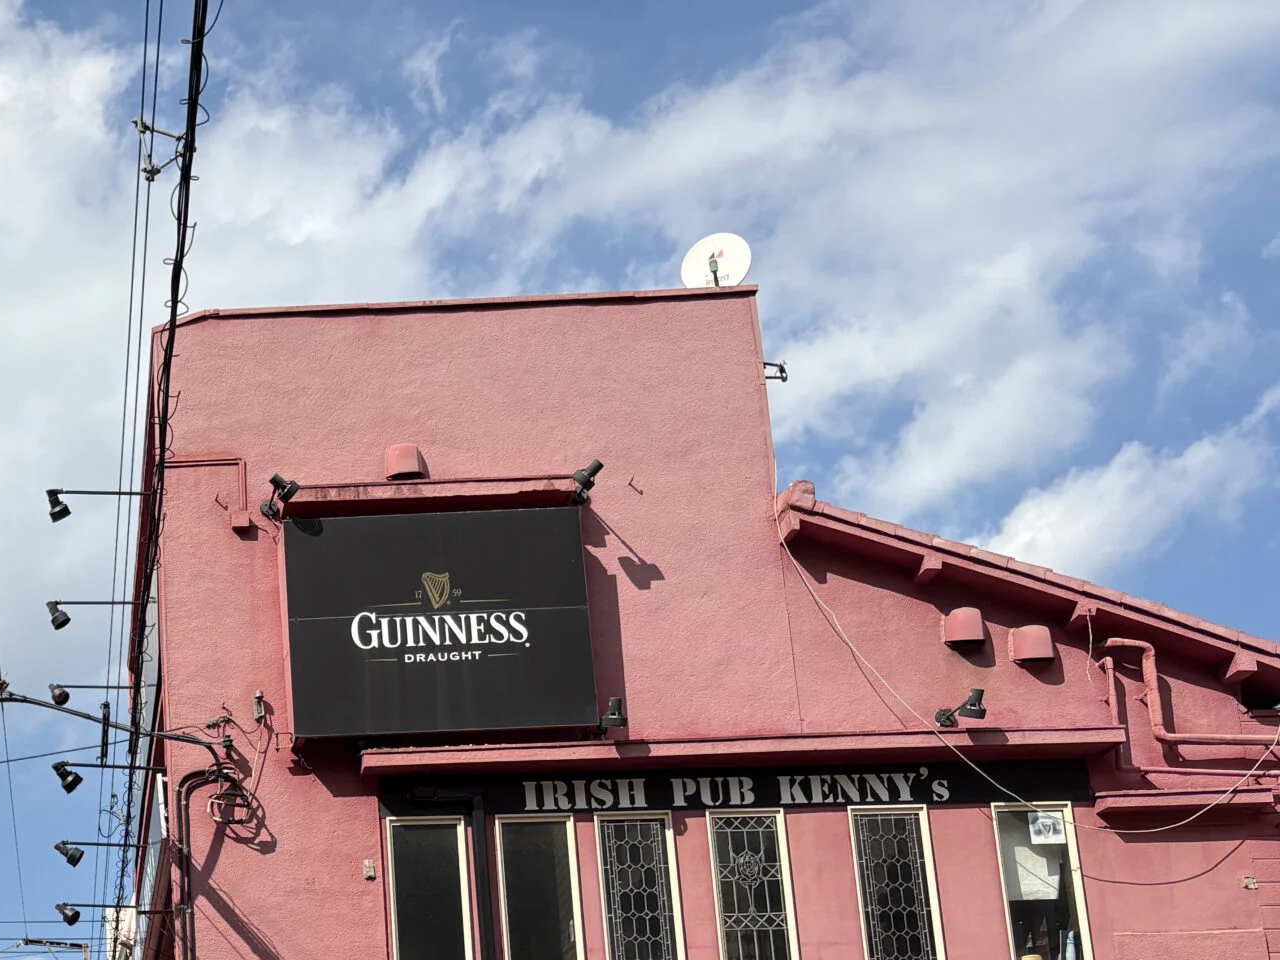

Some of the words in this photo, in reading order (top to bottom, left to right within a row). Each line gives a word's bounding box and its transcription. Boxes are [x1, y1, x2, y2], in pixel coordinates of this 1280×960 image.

[350, 611, 529, 650] GUINNESS
[404, 650, 482, 663] DRAUGHT
[522, 777, 648, 811] IRISH
[670, 776, 756, 807] PUB
